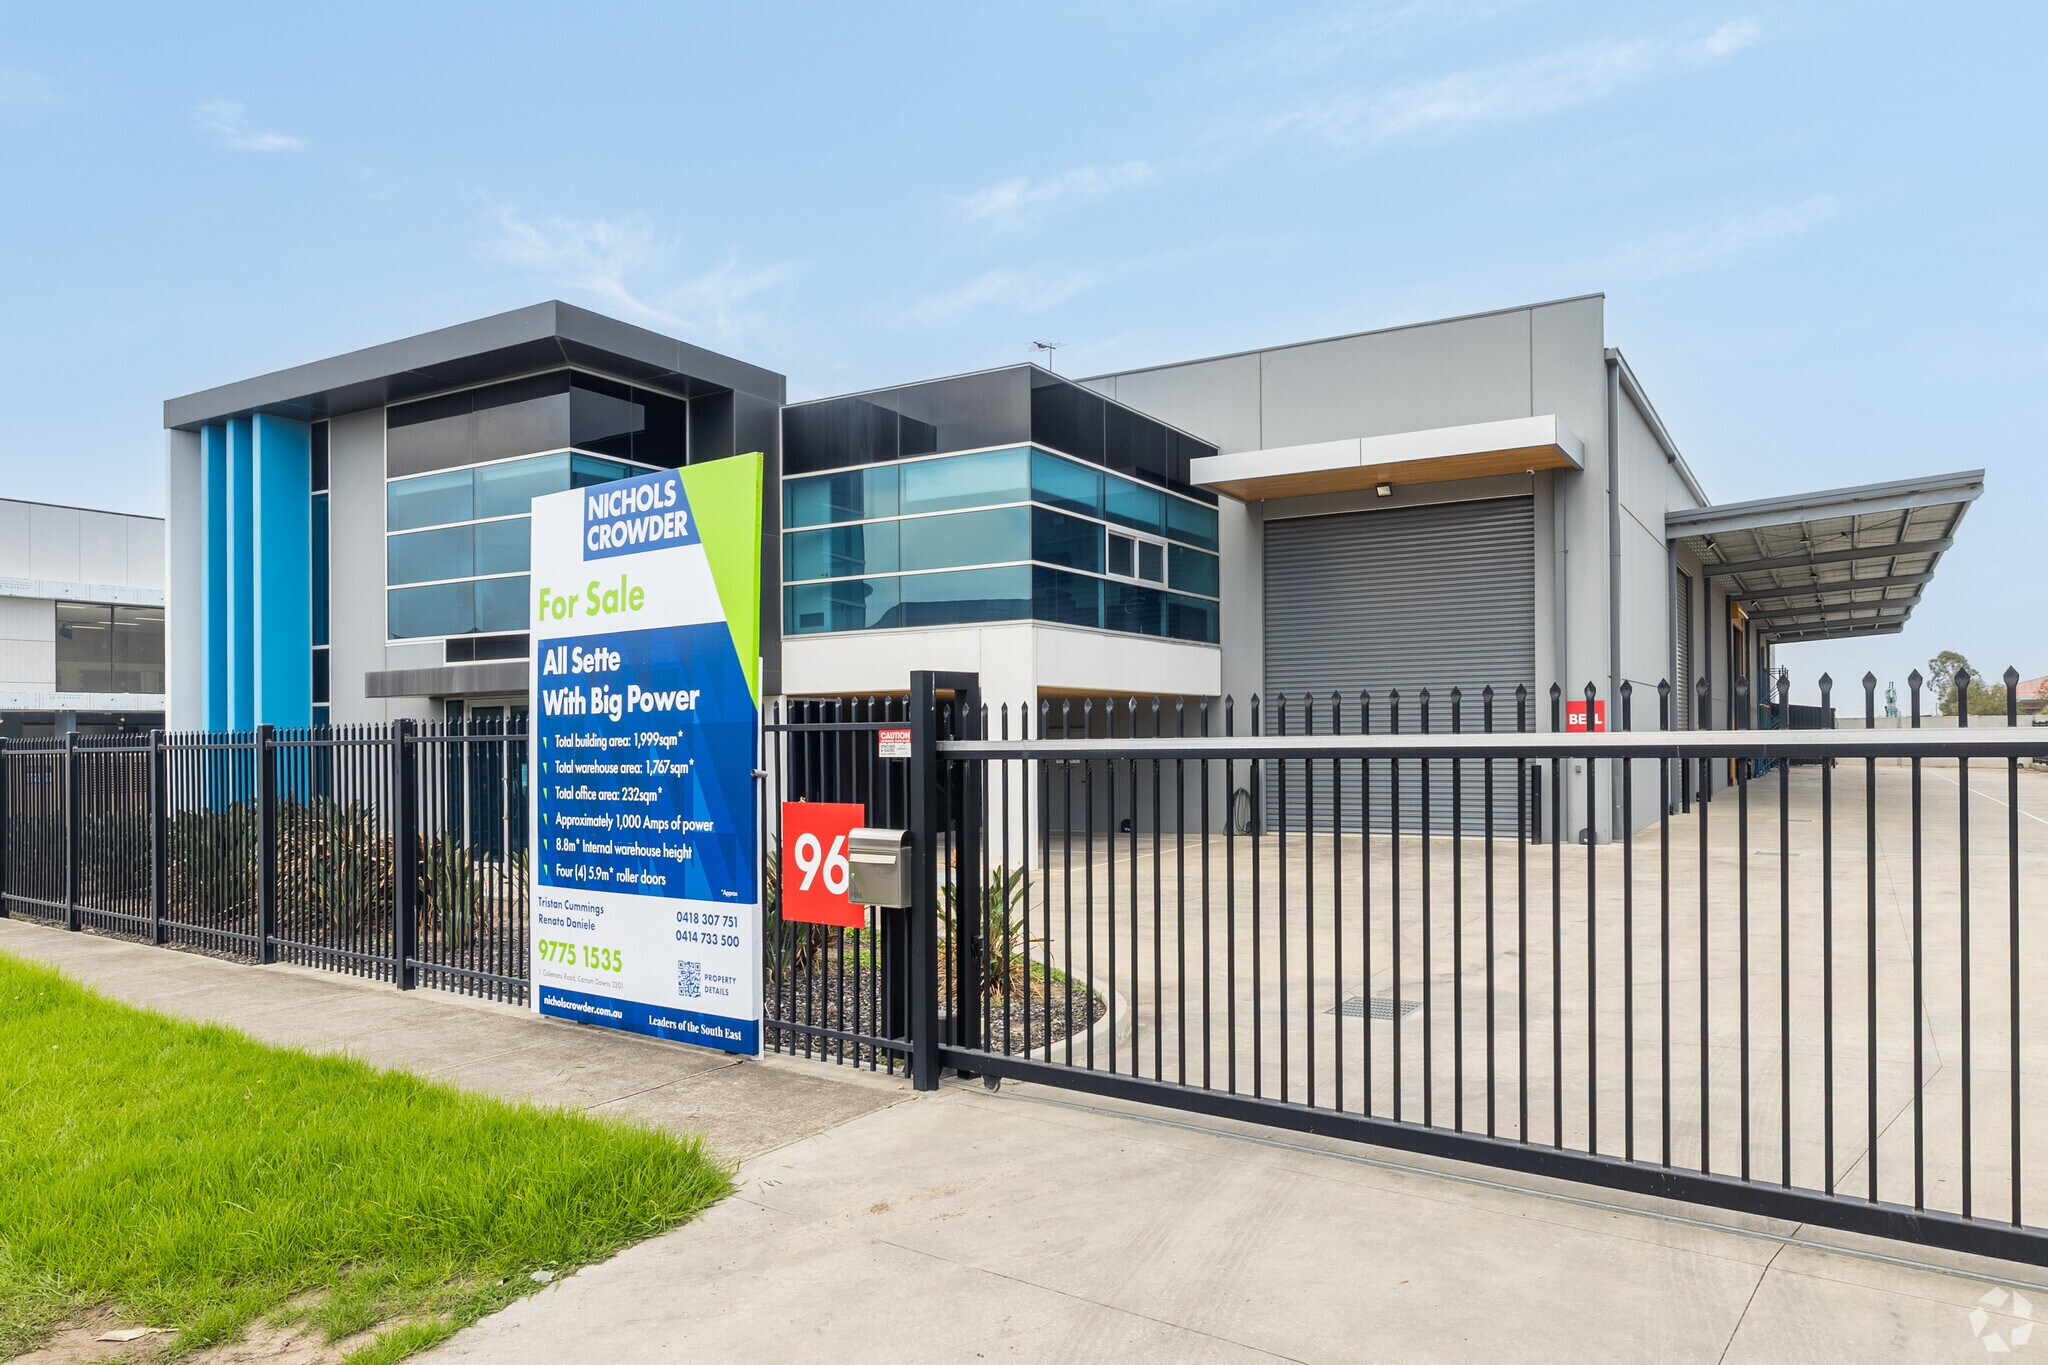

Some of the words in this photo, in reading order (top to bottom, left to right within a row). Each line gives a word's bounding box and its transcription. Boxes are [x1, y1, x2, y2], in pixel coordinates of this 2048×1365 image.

[588, 479, 676, 521] NICHOLS
[587, 510, 688, 551] CROWDER
[539, 587, 578, 621] For
[586, 574, 644, 616] Sale
[543, 645, 568, 675] All
[571, 646, 621, 674] Sette
[543, 686, 586, 716] With
[591, 684, 623, 722] Big
[627, 684, 700, 711] Power
[1569, 713, 1603, 725] BEL
[555, 733, 574, 748] Total
[575, 732, 607, 751] building
[609, 736, 631, 747] area:
[881, 731, 910, 740] CAUTION
[555, 759, 574, 774] Total
[575, 759, 618, 774] warehouse
[620, 763, 643, 774] area:
[555, 785, 574, 800] Total
[575, 785, 596, 800] office
[598, 790, 620, 801] area:
[555, 812, 614, 831] Approximately
[616, 814, 641, 829] 1,000
[642, 815, 669, 833] Amps
[671, 815, 681, 830] of
[682, 819, 714, 835] power
[582, 839, 612, 855] Internal
[614, 841, 661, 858] warehouse
[663, 843, 692, 863] height
[556, 863, 573, 878] Four
[575, 865, 587, 882] (4)
[616, 868, 639, 883] roller
[640, 869, 666, 886] doors
[794, 832, 849, 895] 96
[538, 896, 563, 909] Tristan
[564, 899, 604, 917] Cummings
[538, 914, 564, 927] Renato
[566, 917, 595, 931] Daniele
[677, 911, 699, 924] 0418
[702, 913, 720, 926] 307
[723, 915, 738, 928] 751
[676, 930, 698, 943] 0414
[701, 932, 718, 946] 733
[721, 934, 740, 948] 500
[538, 938, 577, 966] 9775
[583, 945, 623, 973] 1535
[564, 972, 577, 982] Road,
[595, 978, 610, 987] Downs
[611, 980, 624, 989] 3201
[704, 973, 737, 985] PROPERTY
[704, 986, 729, 996] DETAILS
[543, 994, 623, 1019] nicholscrowder.com.au
[648, 1015, 677, 1030] Leaders
[678, 1020, 687, 1031] of
[688, 1021, 699, 1033] the
[700, 1024, 723, 1038] South
[725, 1028, 742, 1041] East
